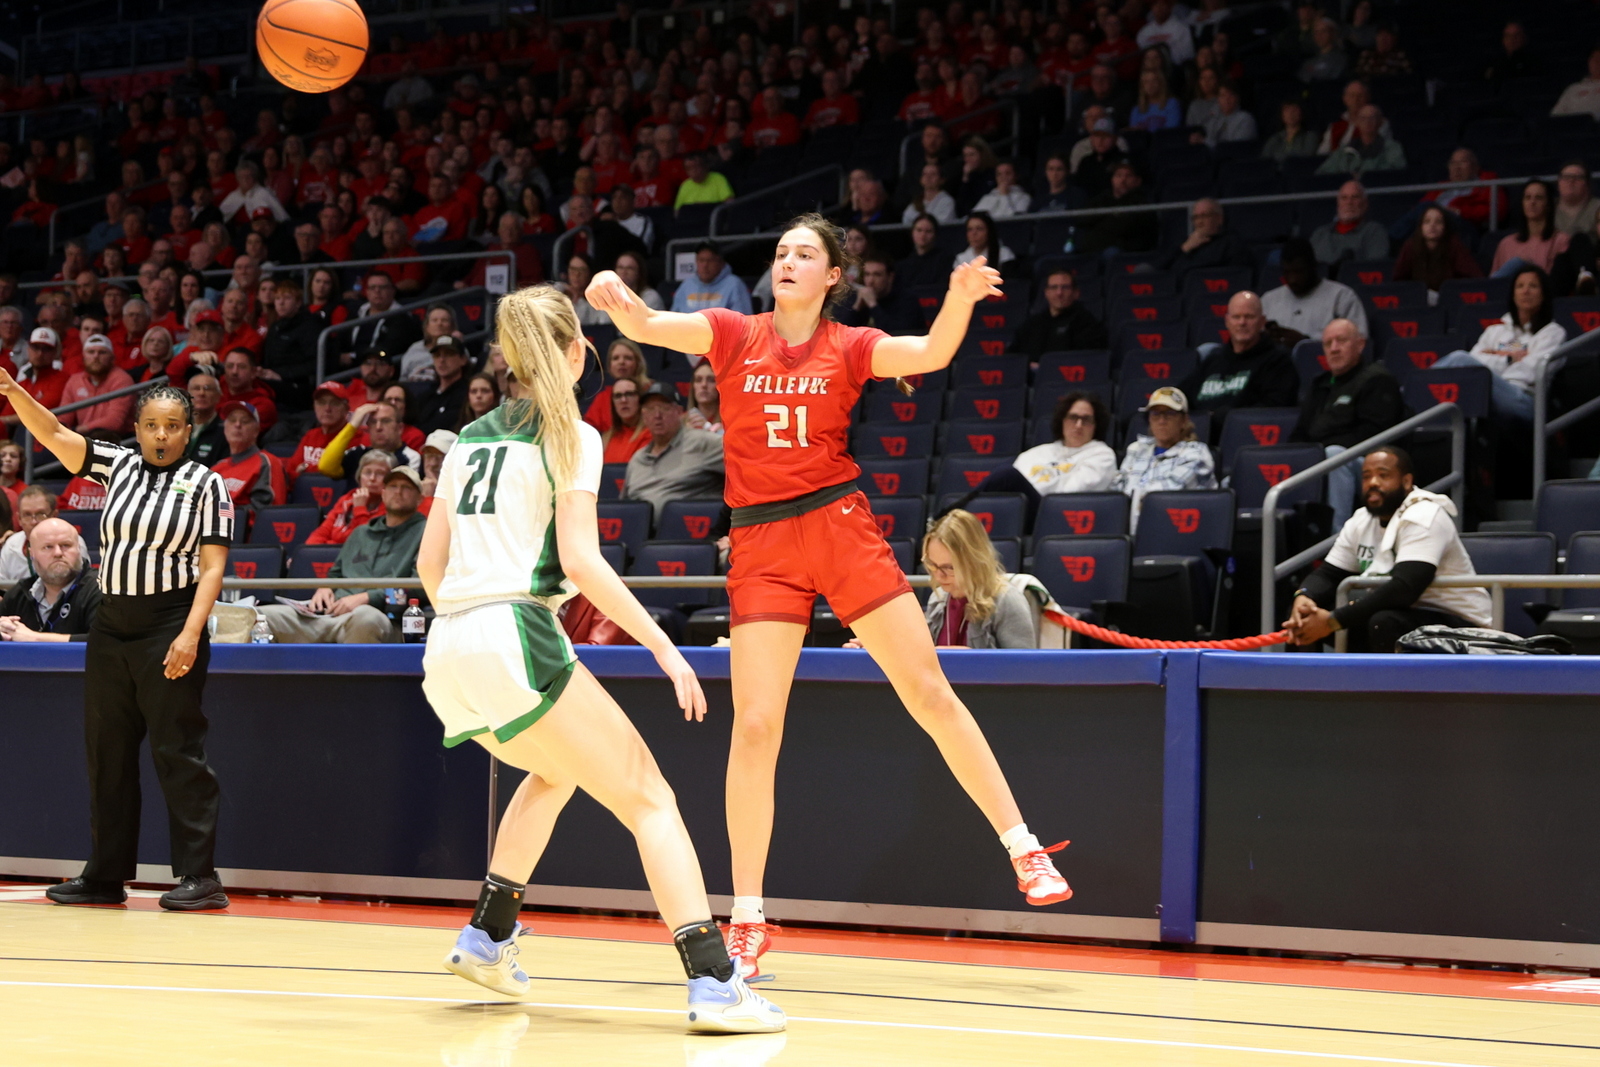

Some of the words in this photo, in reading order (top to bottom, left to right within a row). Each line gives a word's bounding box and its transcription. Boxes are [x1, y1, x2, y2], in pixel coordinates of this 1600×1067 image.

[743, 374, 831, 395] BELLEVUE
[764, 404, 809, 448] 21
[456, 446, 508, 516] 21
